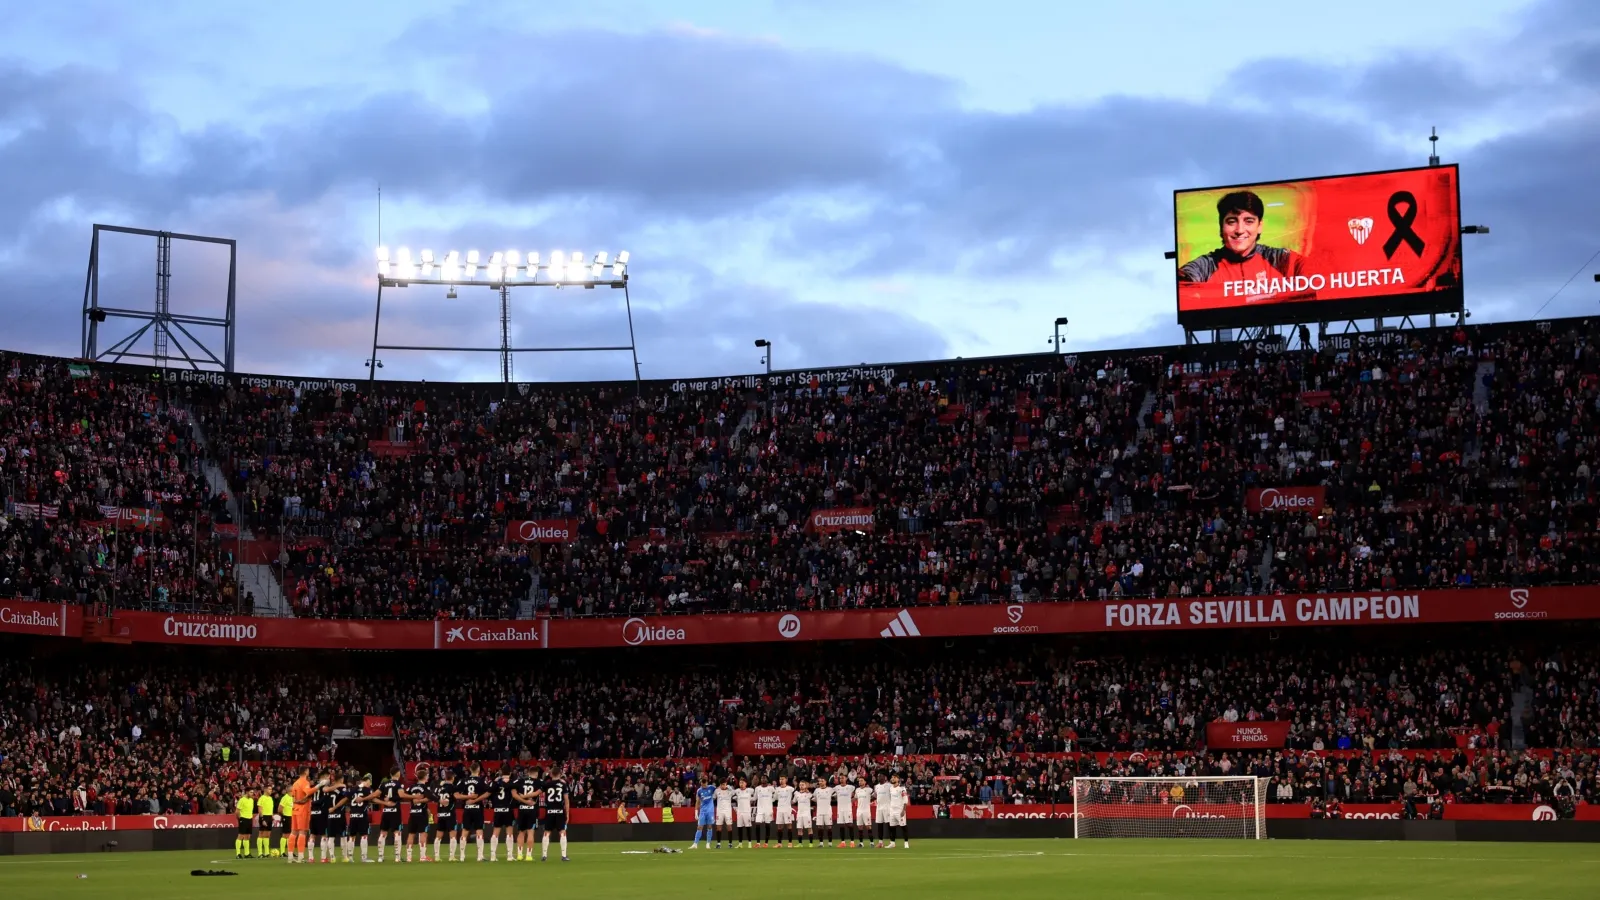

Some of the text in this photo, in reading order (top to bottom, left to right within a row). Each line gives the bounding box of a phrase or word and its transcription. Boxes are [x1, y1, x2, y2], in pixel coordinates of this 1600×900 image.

[1224, 267, 1405, 297] FERNANDO HUERTA
[162, 368, 177, 382] La
[181, 370, 225, 386] Giralda
[671, 380, 687, 393] de
[690, 381, 708, 391] ver
[724, 375, 762, 389] Seilla
[1264, 491, 1315, 509] Midea
[814, 514, 876, 526] Cruzcampo
[523, 524, 569, 539] Midea
[0, 608, 59, 627] CaixaBank
[1105, 595, 1419, 626] FORZA SEVILLA CAMPEON
[1494, 611, 1548, 619] socios.com
[164, 616, 257, 642] Cruzcampo
[628, 622, 686, 643] Midea
[781, 619, 798, 632] JD
[993, 625, 1039, 633] socios.com
[467, 627, 540, 641] CaixaBank
[1236, 727, 1262, 735] NUNCA
[758, 735, 781, 743] NUNCA
[497, 786, 506, 800] 3
[523, 784, 535, 796] 12
[547, 787, 563, 802] 23
[1345, 812, 1427, 820] socios
[1539, 810, 1554, 821] JD
